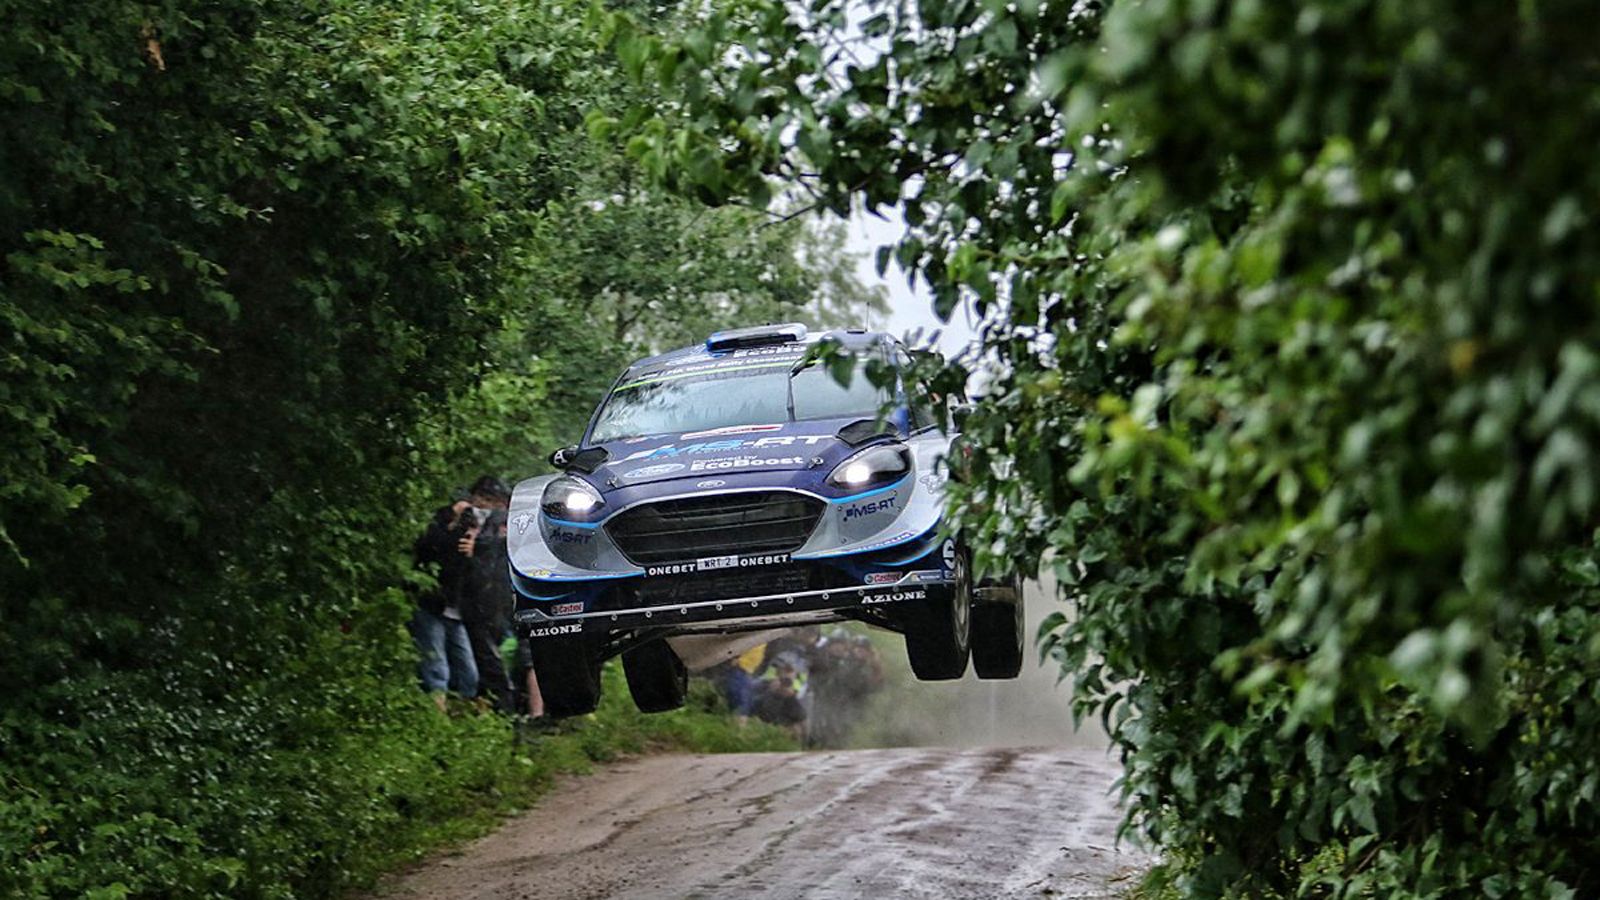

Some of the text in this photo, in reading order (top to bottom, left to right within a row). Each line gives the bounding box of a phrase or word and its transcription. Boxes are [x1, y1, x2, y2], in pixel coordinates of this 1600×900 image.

[745, 355, 803, 365] Champions
[690, 456, 804, 471] EcoBoost
[648, 563, 697, 576] ONEBET
[740, 554, 789, 567] ONEBET
[861, 590, 927, 604] AZIONE
[529, 624, 583, 637] AZIONE
